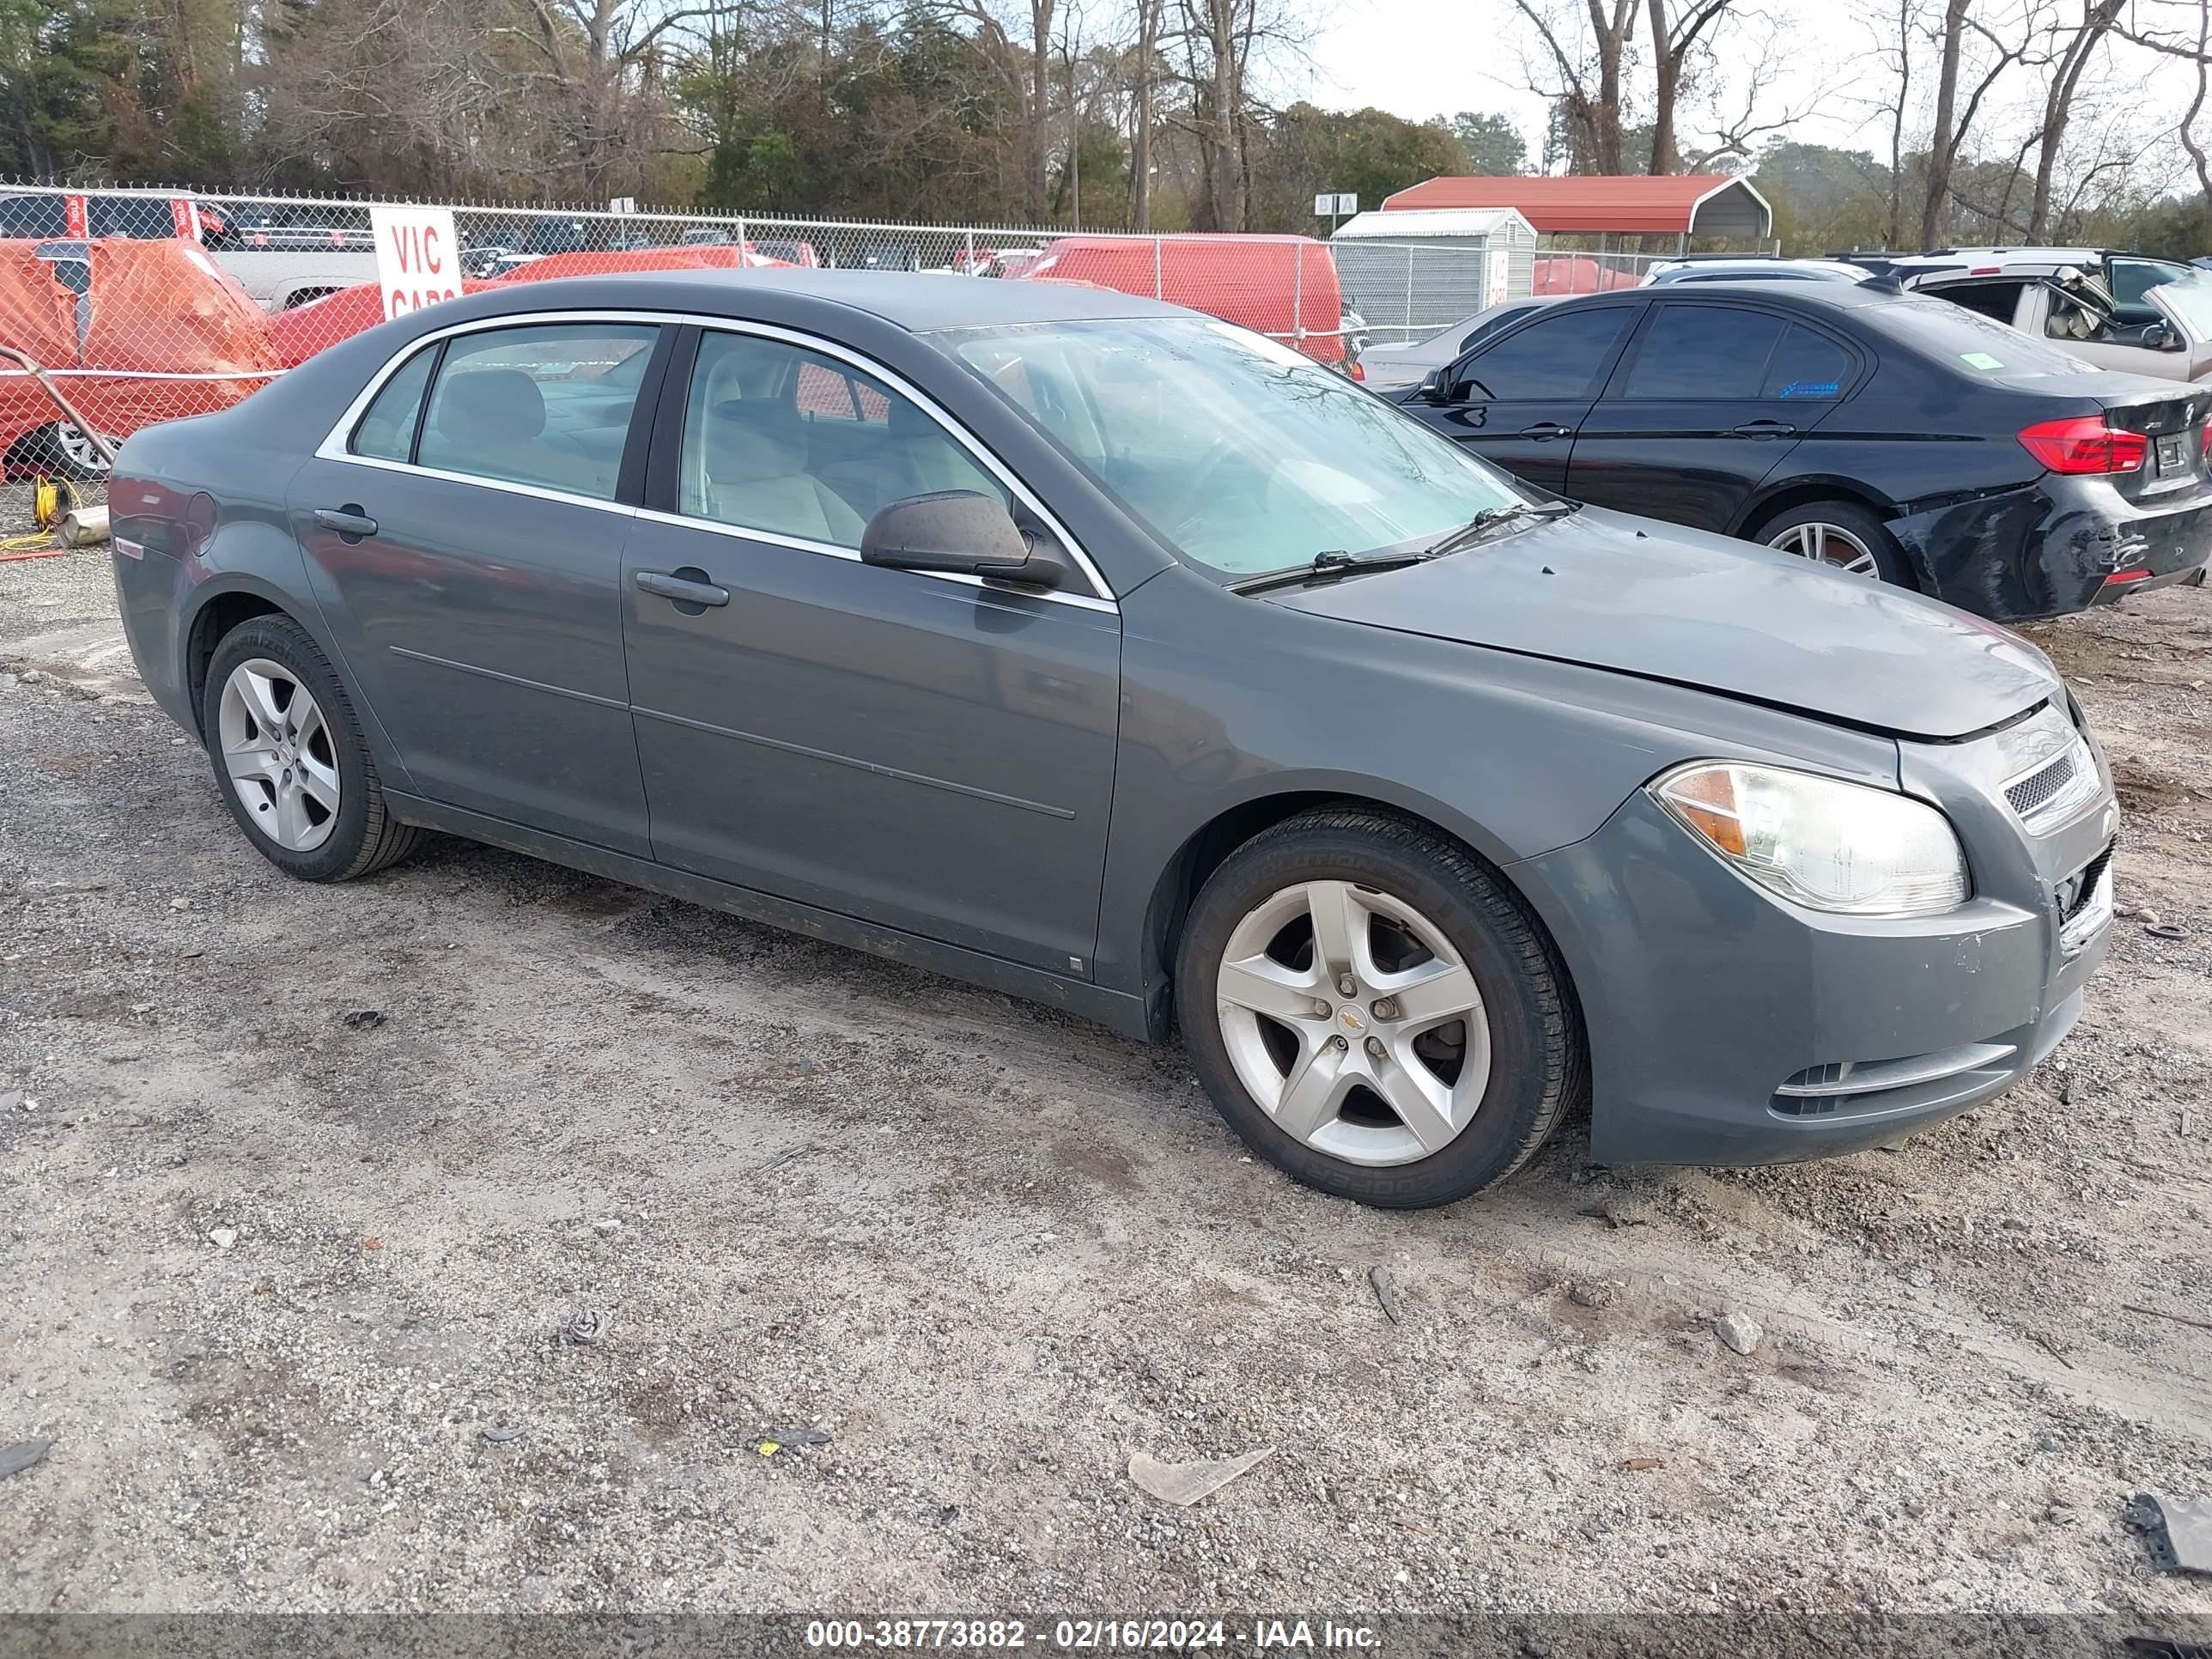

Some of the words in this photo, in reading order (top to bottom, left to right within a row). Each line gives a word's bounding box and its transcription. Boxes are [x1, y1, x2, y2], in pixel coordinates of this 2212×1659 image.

[1319, 198, 1328, 212] B
[1341, 197, 1354, 212] A
[391, 225, 441, 275] VIC
